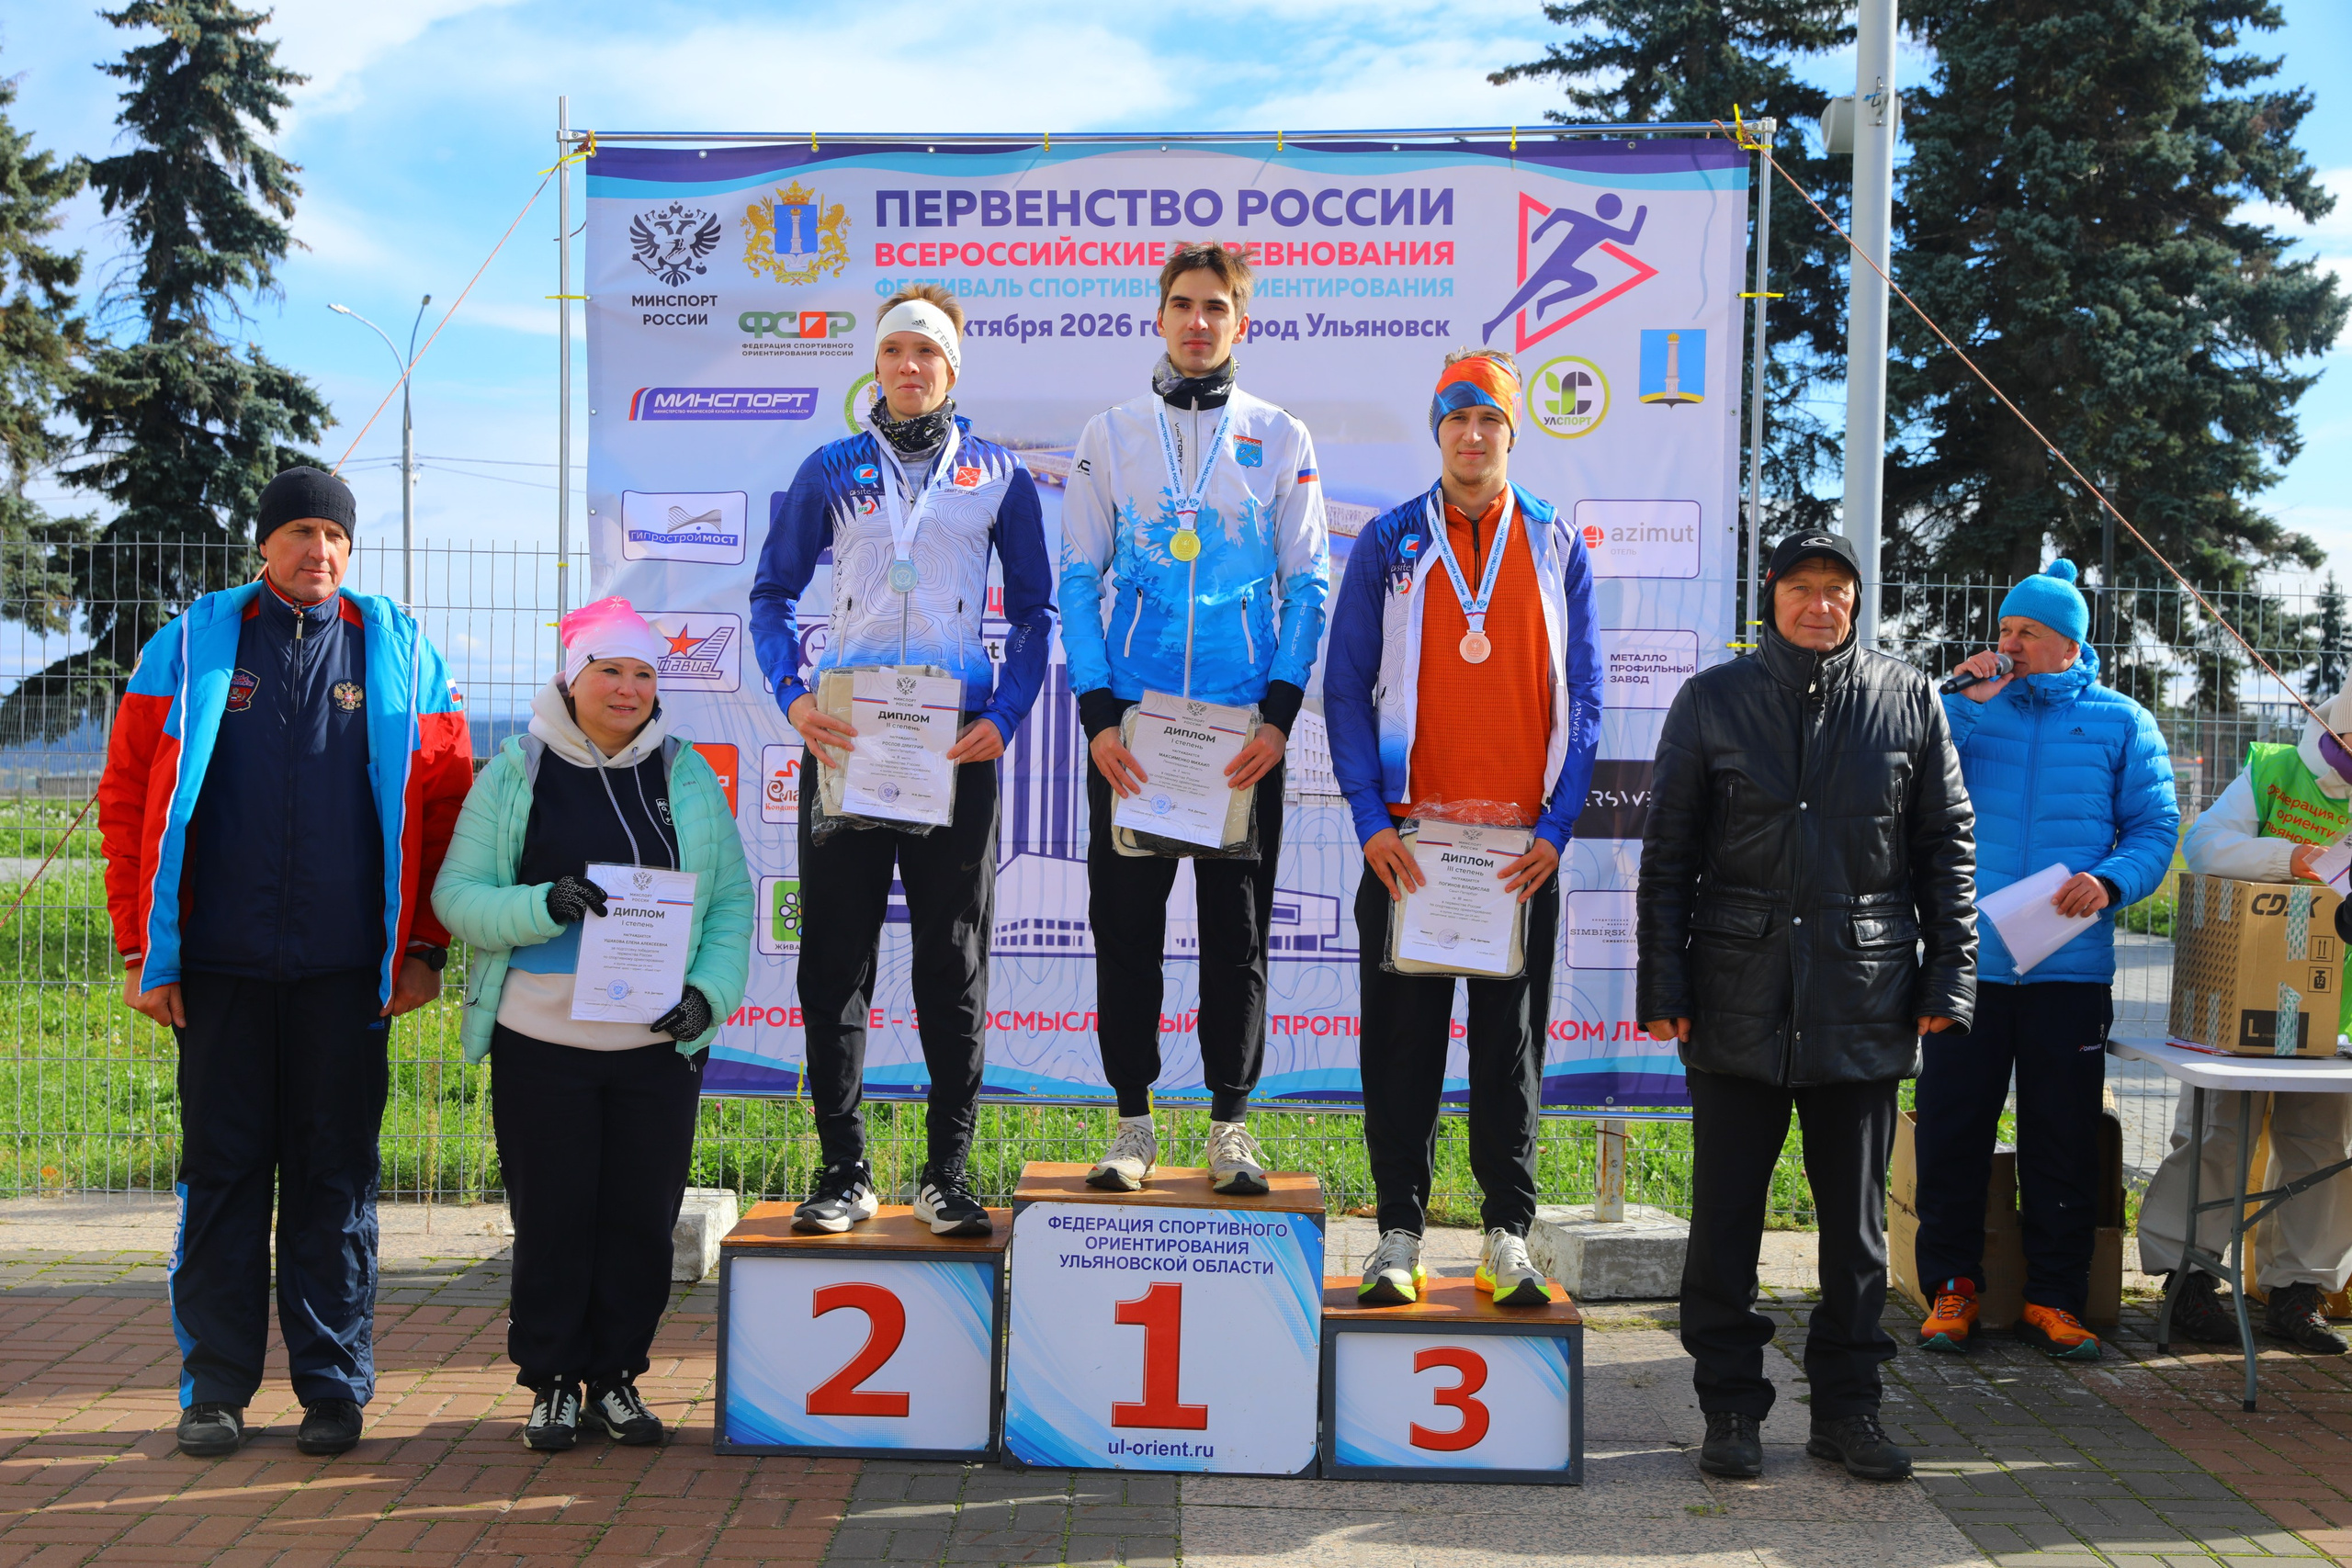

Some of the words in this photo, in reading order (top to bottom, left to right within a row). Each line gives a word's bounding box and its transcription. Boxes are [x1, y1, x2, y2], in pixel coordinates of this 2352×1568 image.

[875, 188, 1224, 228] ПЕРВЕНСТВО
[1237, 187, 1454, 227] РОССИИ
[875, 236, 1166, 267] ВСЕРОССИЙСКИЕ
[1174, 242, 1454, 266] РЕВНОВАНИЯ
[631, 295, 718, 307] МИНСПОРТ
[642, 313, 708, 325] РОССИИ
[963, 313, 1053, 344] ктября
[1060, 314, 1133, 337] 2026
[1306, 312, 1451, 340] Ульяновск
[654, 393, 810, 407] МИНСПОРТ
[1167, 451, 1176, 472] СПОРТА
[1195, 456, 1214, 494] МИНИСТЕРСТВО
[1210, 435, 1223, 457] СПОРТА
[1218, 416, 1229, 436] РОССИИ
[1611, 522, 1694, 543] azimut
[1445, 554, 1457, 574] СПОРТА
[1453, 574, 1466, 596] РОССИИ
[1482, 557, 1498, 594] МИНИСТЕРСТВО
[1494, 537, 1503, 557] СПОРТА
[1610, 654, 1668, 662] МЕТАЛЛО
[1610, 663, 1694, 672] ПРОФИЛЬНЫЙ
[1610, 675, 1650, 684] ЗАВОД
[877, 710, 930, 723] ДИПЛОМ
[891, 723, 920, 731] степень
[1163, 726, 1216, 743] ДИПЛОМ
[1174, 739, 1204, 750] степень
[1159, 752, 1191, 763] МАКСИМЕНКО
[1191, 760, 1211, 768] МИХАИЛ
[1441, 852, 1495, 868] ДИПЛОМ
[1454, 867, 1485, 876] степень
[613, 907, 665, 919] ДИПЛОМ
[2251, 893, 2323, 918] CDK
[2247, 1019, 2259, 1038] L
[1047, 1215, 1154, 1234] ФЕДЕРАЦИЯ
[1159, 1219, 1288, 1237] СПОРТИВНОГО
[1084, 1236, 1250, 1255] ОРИЕНТИРОВАНИЯ
[1058, 1253, 1187, 1272] УЛЬЯНОВСКОЙ
[1192, 1258, 1274, 1275] ОБЛАСТИ
[806, 1280, 910, 1418] 2
[1111, 1280, 1209, 1431] 1
[1409, 1346, 1490, 1452] 3
[1107, 1438, 1215, 1459] ul-orient.ru
